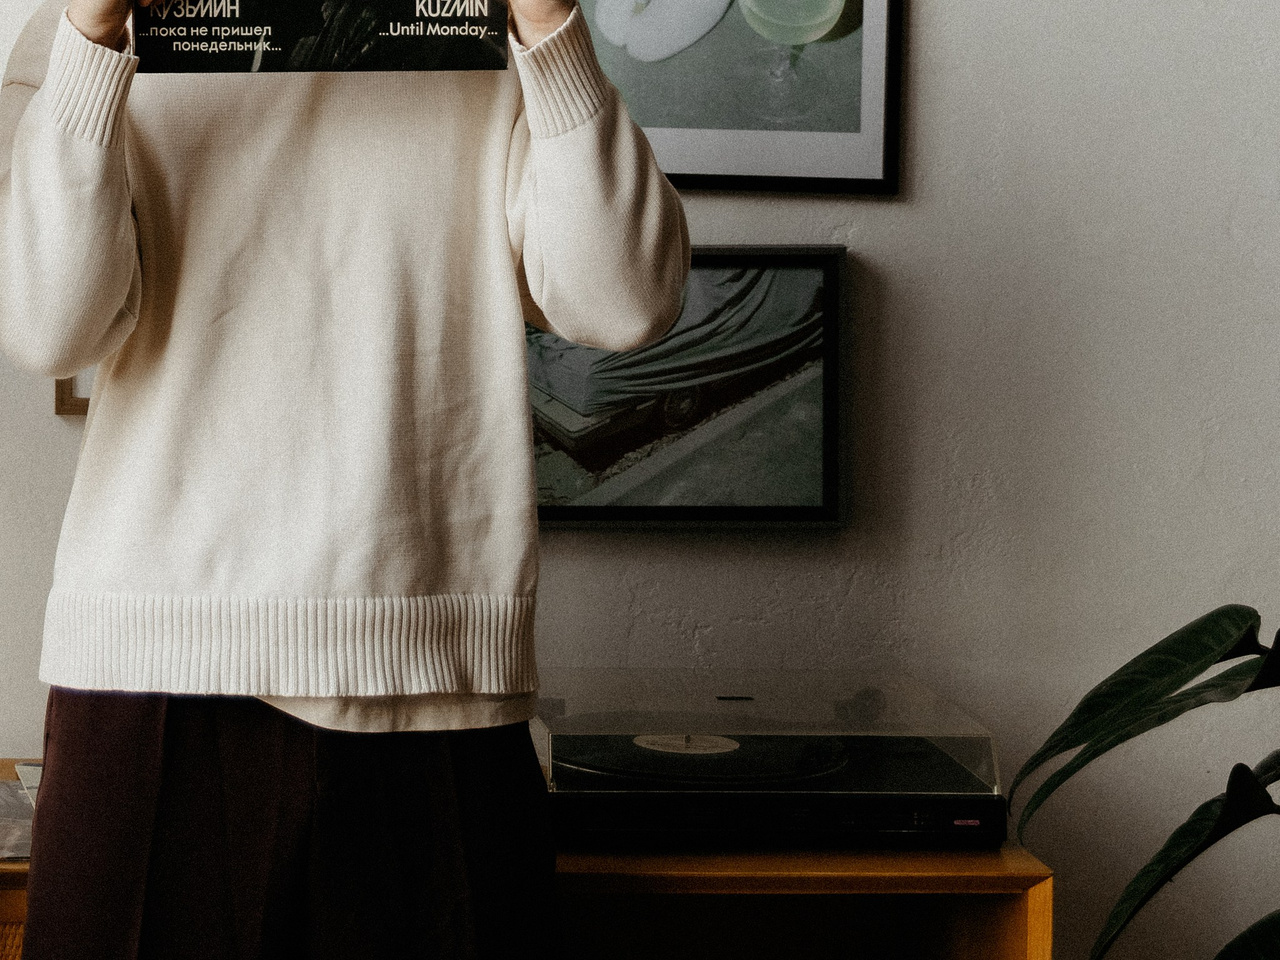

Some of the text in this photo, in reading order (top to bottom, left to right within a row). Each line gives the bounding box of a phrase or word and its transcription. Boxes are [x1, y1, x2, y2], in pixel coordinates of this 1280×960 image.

[190, 26, 209, 36] не
[211, 26, 272, 40] пришел
[379, 21, 498, 39] ...Until Monday...
[173, 41, 282, 53] понедельник...
